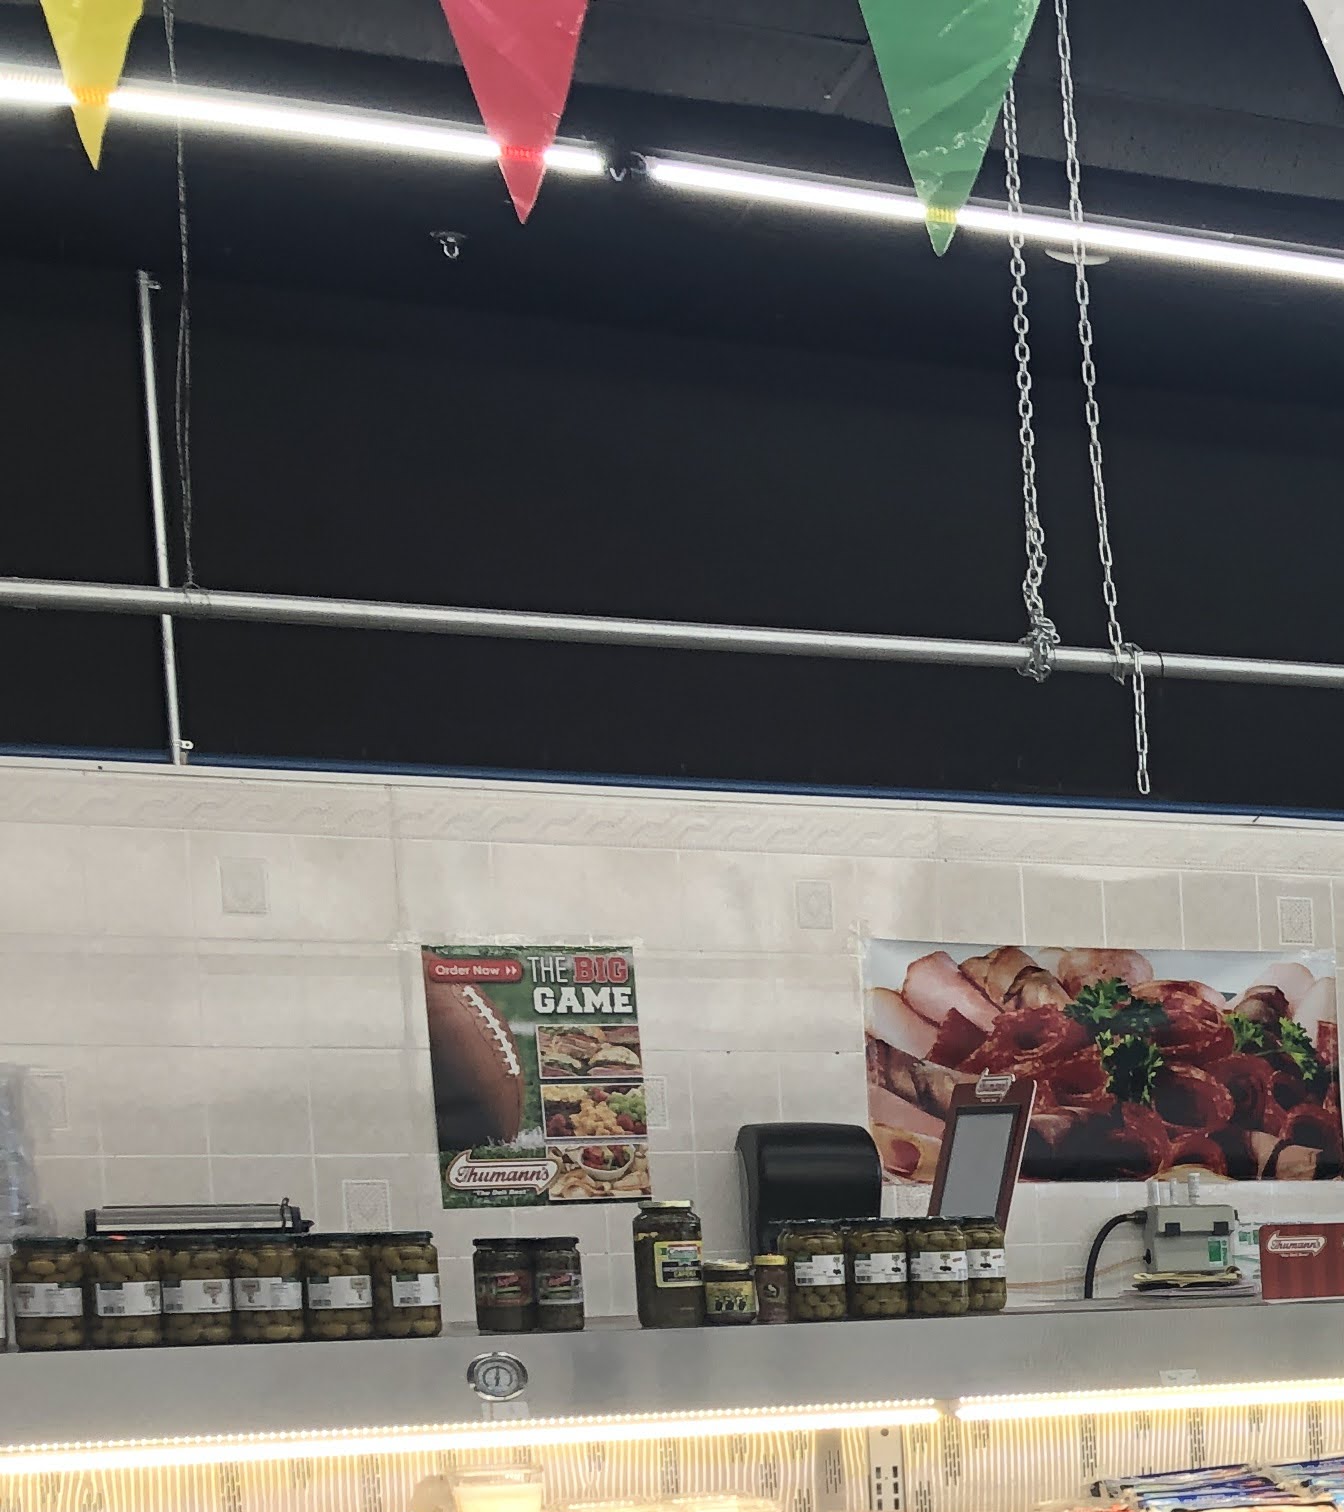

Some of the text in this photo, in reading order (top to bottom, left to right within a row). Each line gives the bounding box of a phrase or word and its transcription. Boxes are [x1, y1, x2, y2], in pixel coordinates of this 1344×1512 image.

[435, 965, 500, 976] Order Now
[527, 957, 628, 983] THE BIG
[534, 987, 633, 1014] GAME
[455, 1165, 550, 1183] Thumann's
[1268, 1235, 1325, 1255] Thumann's
